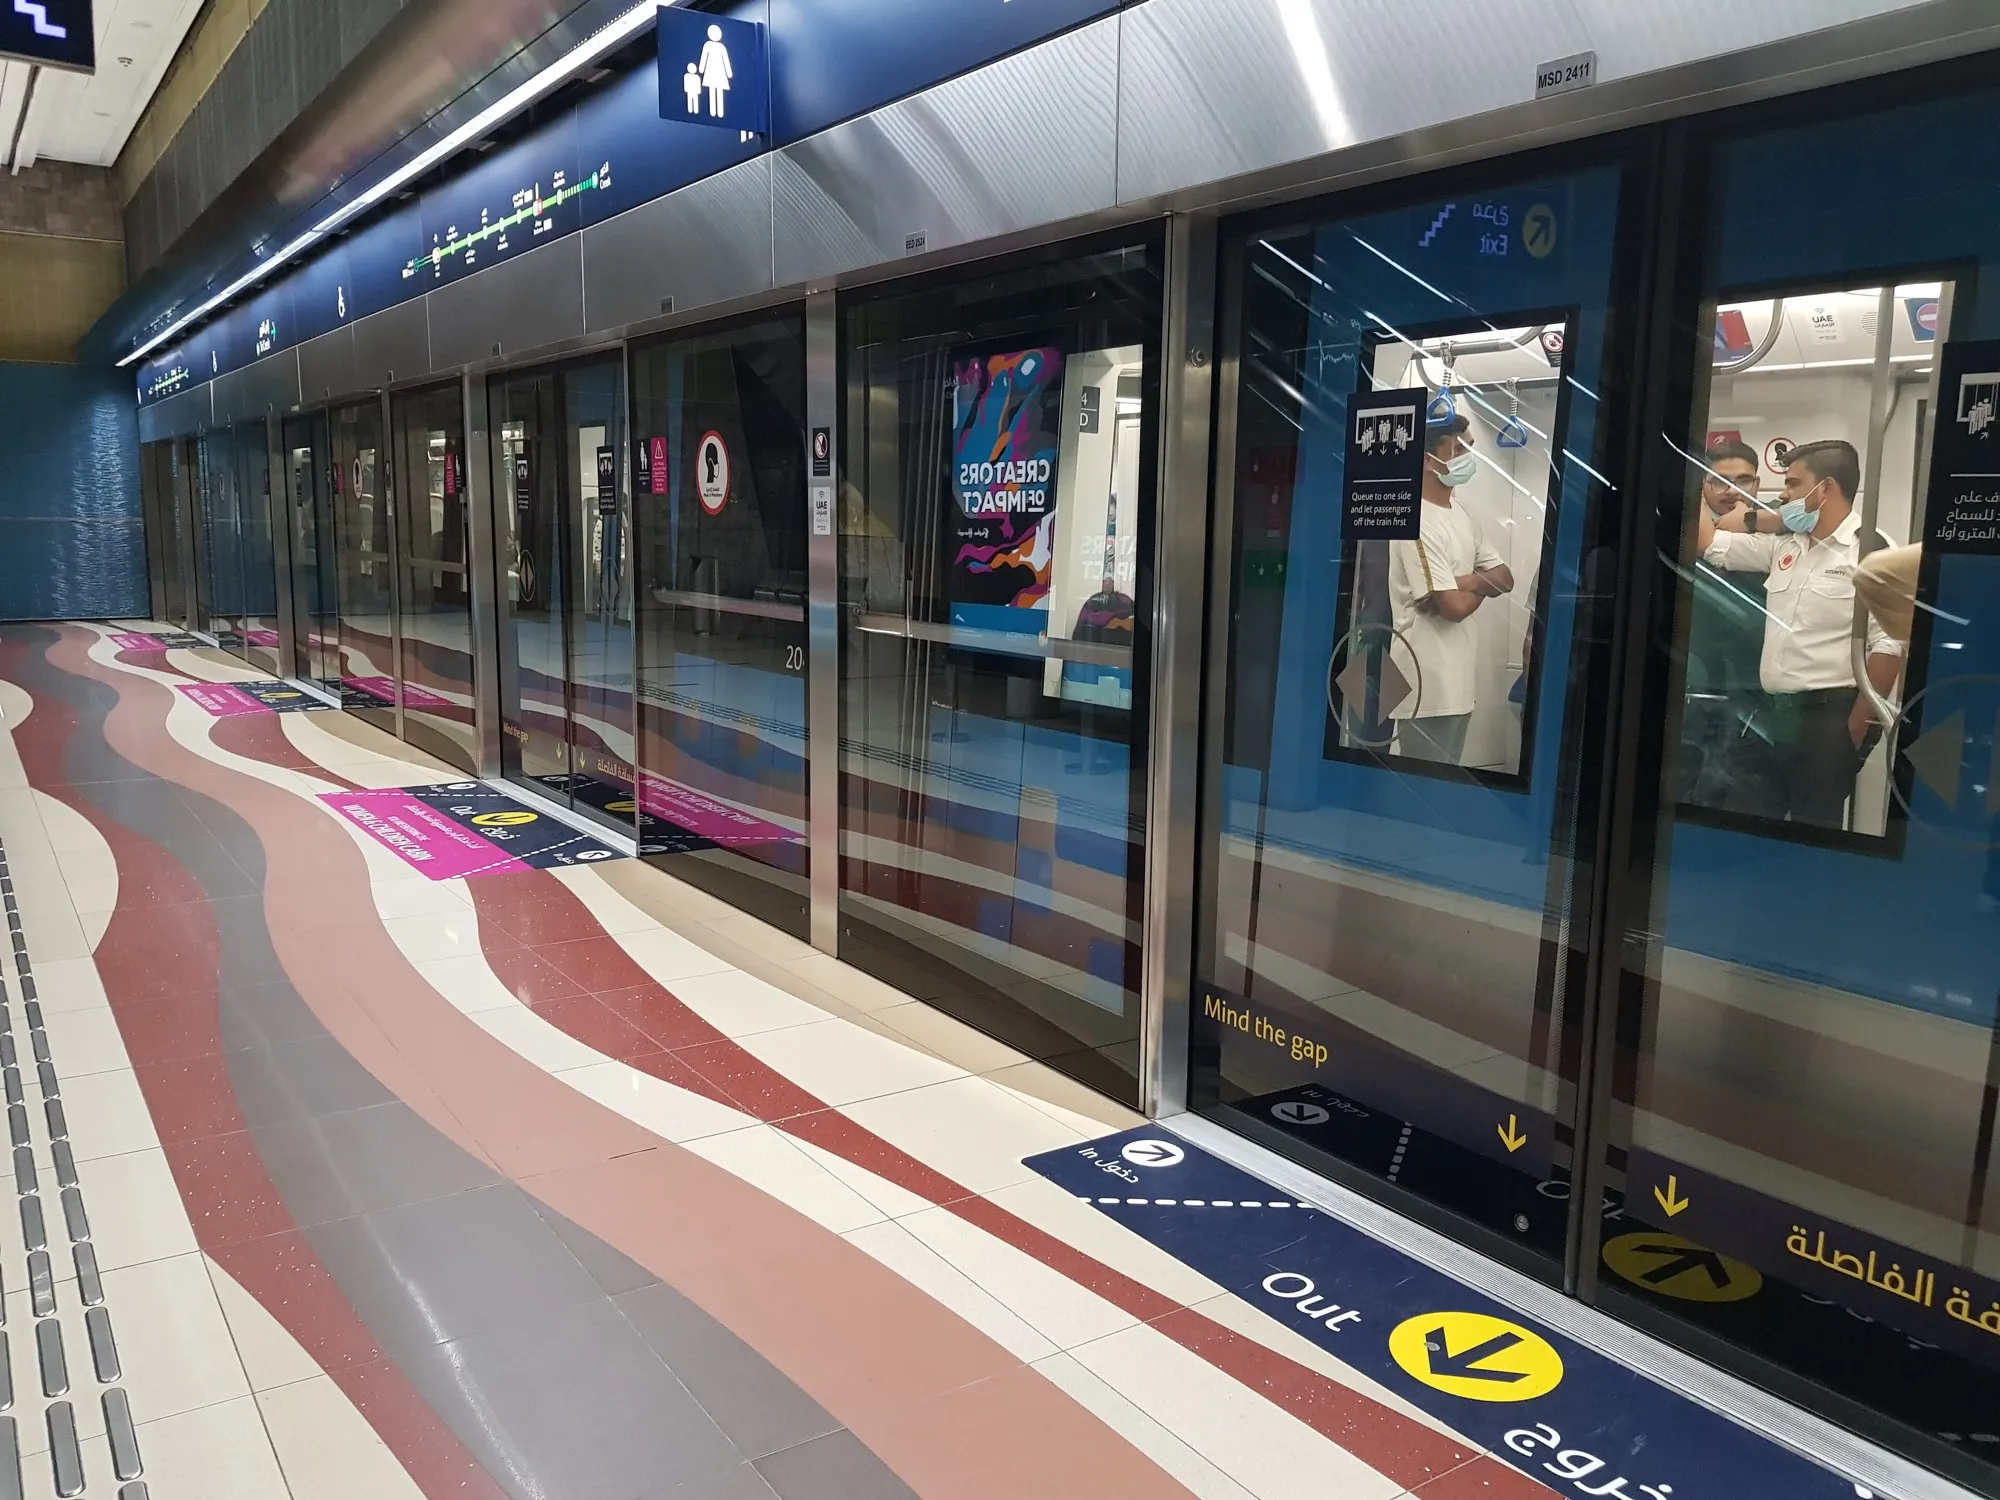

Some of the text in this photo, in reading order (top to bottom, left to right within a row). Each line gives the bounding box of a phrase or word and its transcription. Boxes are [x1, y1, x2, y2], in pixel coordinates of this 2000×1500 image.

[1538, 62, 1590, 89] MSD 2411
[1812, 314, 1833, 324] UAE
[1082, 392, 1088, 405] 4
[1080, 412, 1088, 426] D
[1352, 492, 1373, 501] Queue
[1397, 491, 1412, 500] side
[1954, 491, 1982, 504] على
[816, 501, 827, 509] UAE
[1350, 505, 1412, 515] and let passengers
[1354, 517, 1406, 526] off the train first
[1946, 508, 1994, 523] للسماح
[1958, 527, 1995, 541] المترو
[786, 645, 805, 670] 20
[450, 806, 478, 816] Out
[338, 804, 379, 821] WOMEN
[365, 823, 414, 846] CHILDREN
[395, 844, 436, 860] CABIN
[1205, 994, 1328, 1068] Mind the gap
[1078, 1147, 1139, 1183] In دخول
[1786, 1224, 1935, 1308] الفاصلة
[1262, 1272, 1362, 1332] Out
[1504, 1422, 1673, 1500] خروج
